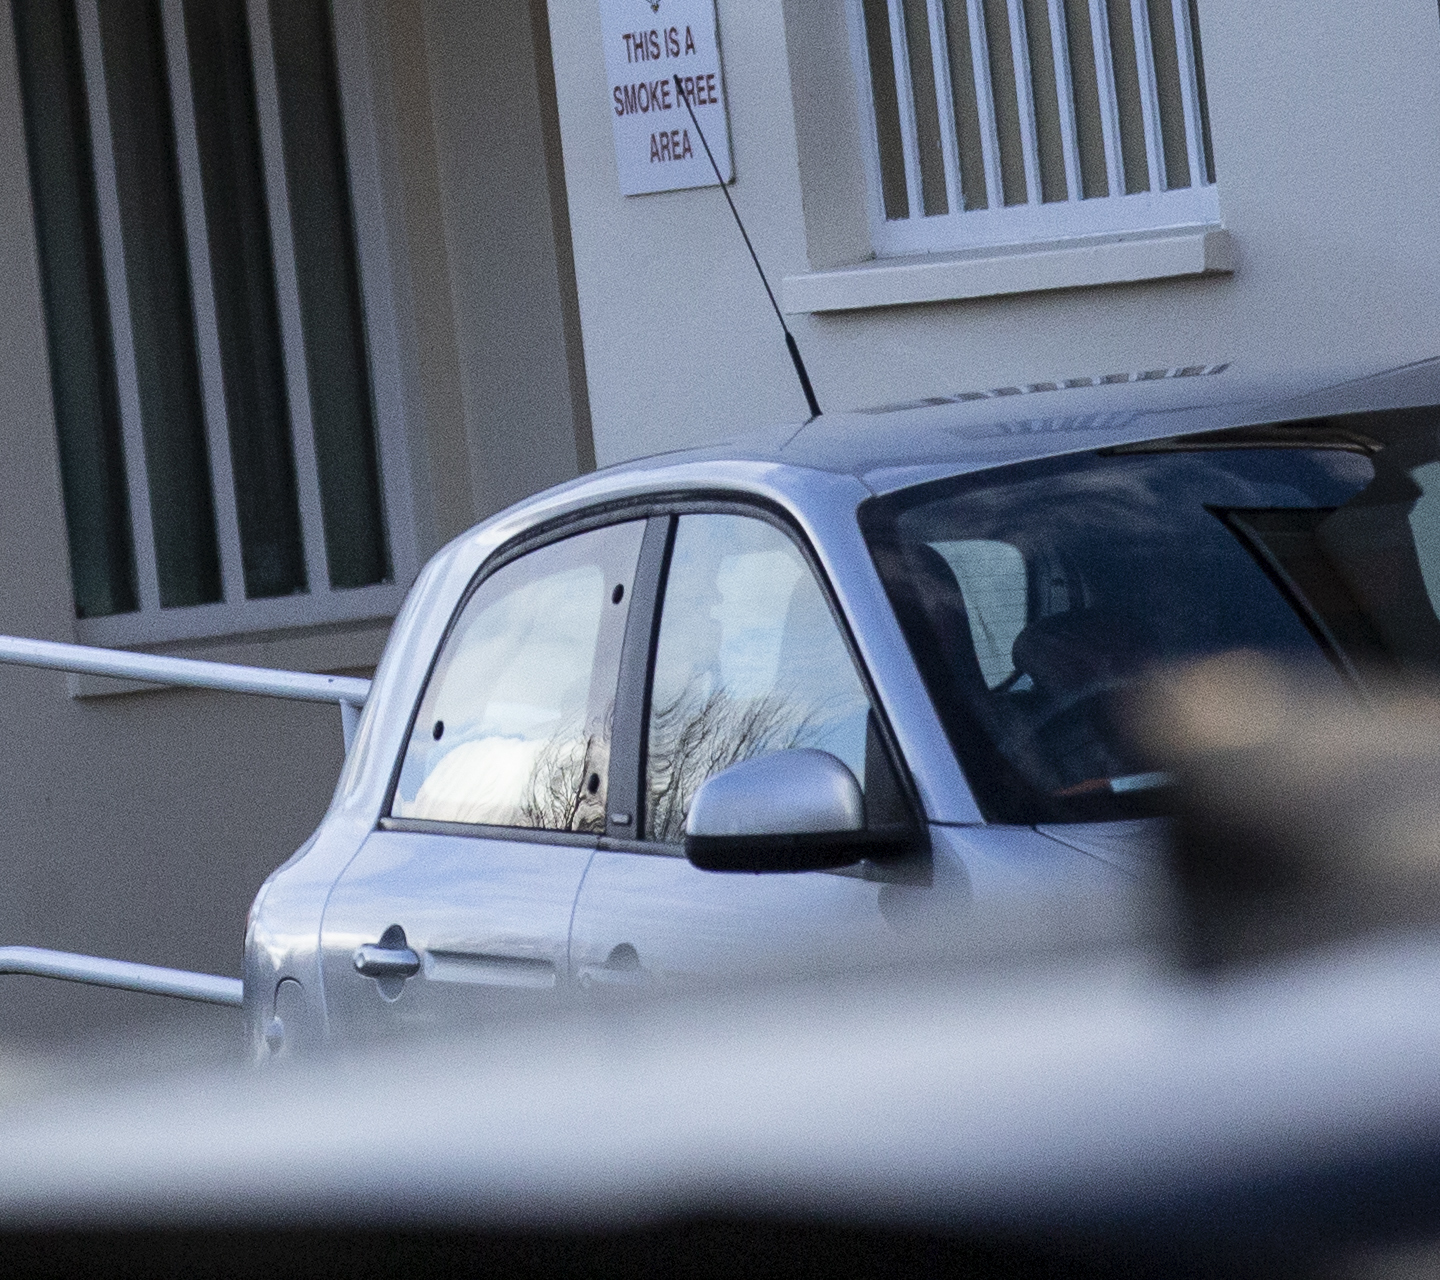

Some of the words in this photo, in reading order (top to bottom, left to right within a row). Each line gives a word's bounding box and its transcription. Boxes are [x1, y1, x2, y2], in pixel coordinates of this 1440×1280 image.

[622, 29, 661, 63] THIS
[663, 26, 680, 58] IS
[684, 25, 696, 56] A
[613, 79, 672, 116] SMOKE
[650, 129, 694, 163] AREA
